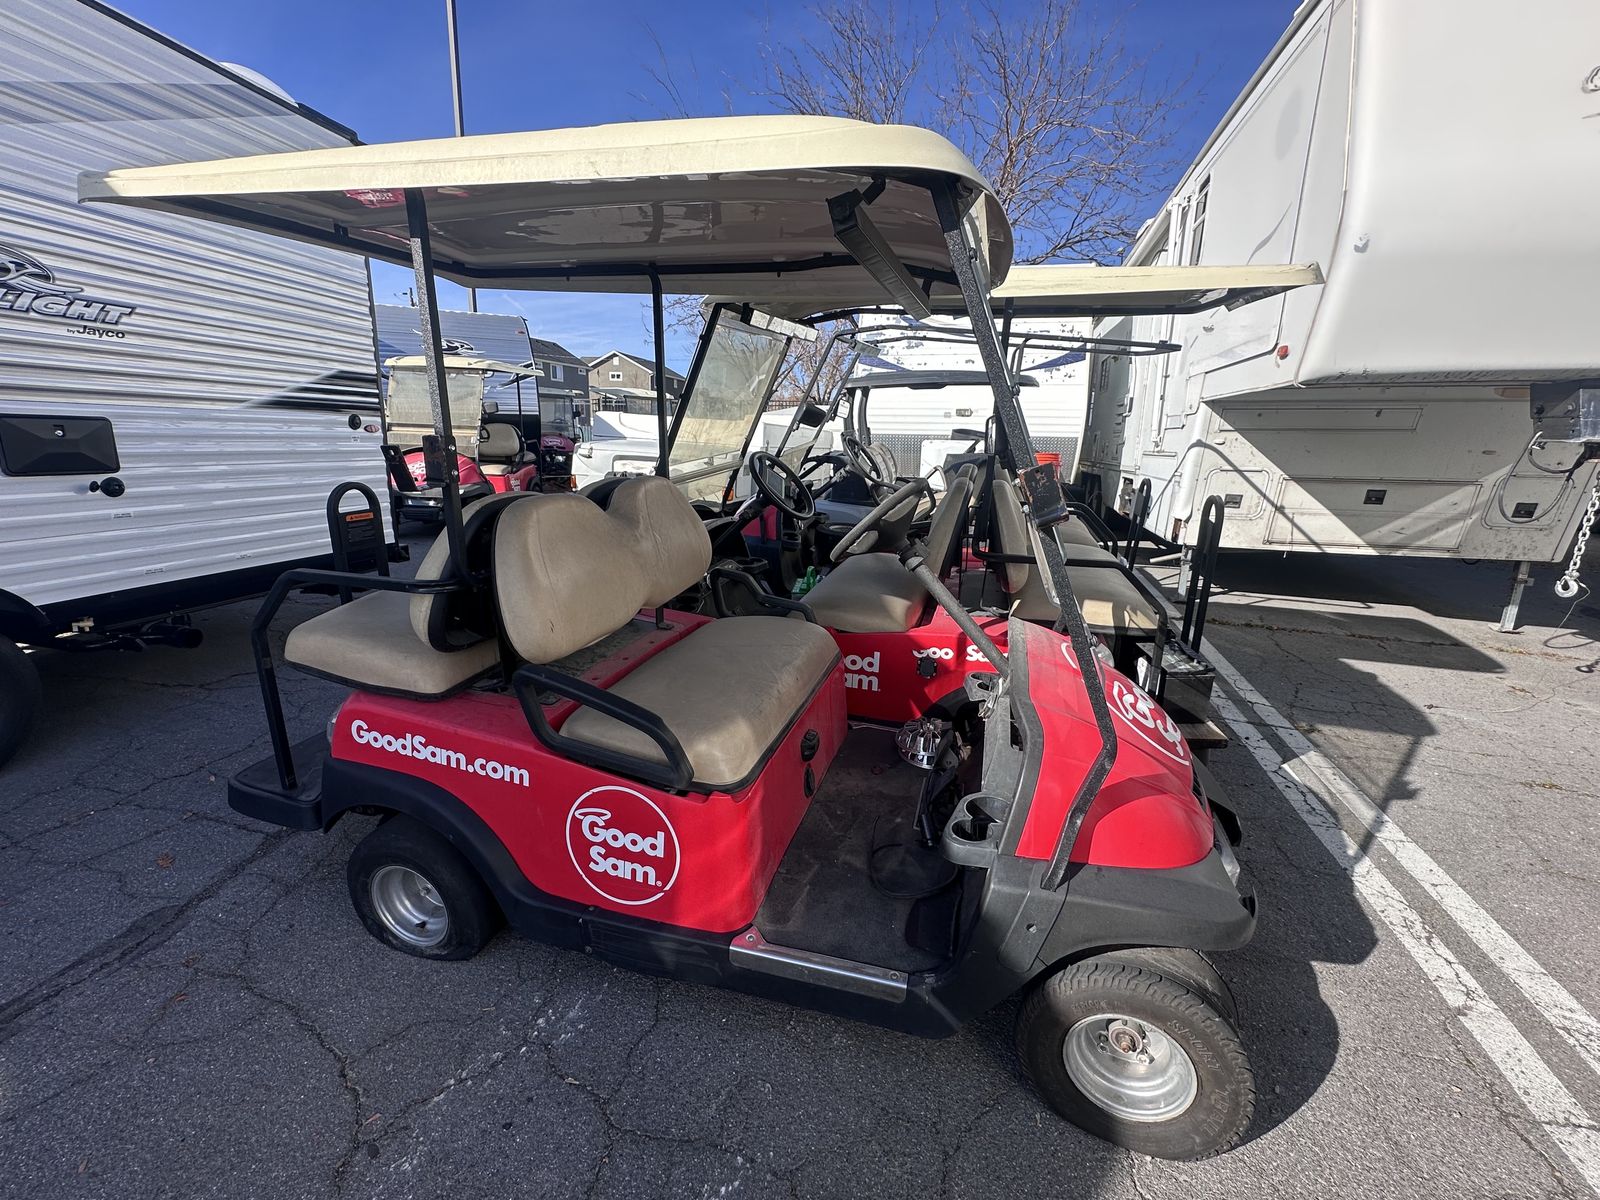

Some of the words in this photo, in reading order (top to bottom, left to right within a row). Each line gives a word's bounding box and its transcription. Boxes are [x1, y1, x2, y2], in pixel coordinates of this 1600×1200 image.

[76, 325, 126, 339] Jayco
[845, 651, 881, 673] od
[350, 719, 530, 787] GoodSam.com
[581, 814, 665, 858] Good
